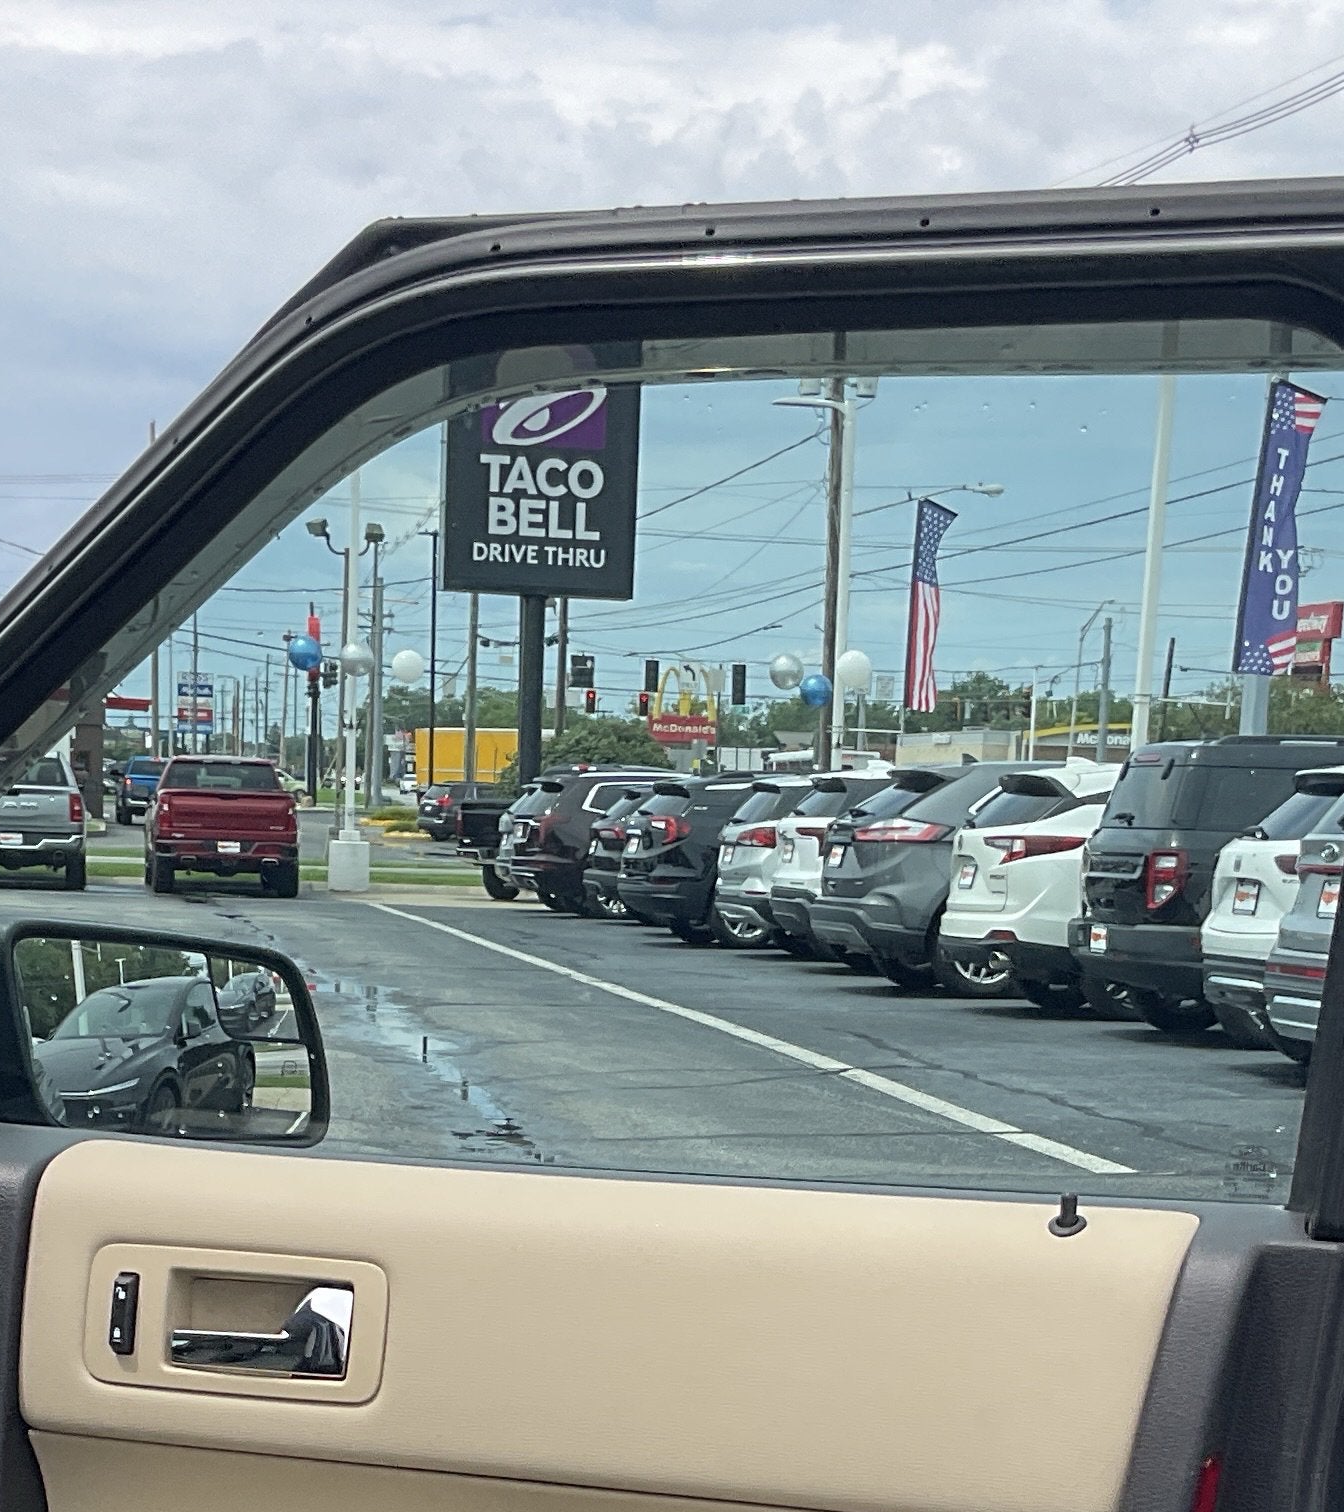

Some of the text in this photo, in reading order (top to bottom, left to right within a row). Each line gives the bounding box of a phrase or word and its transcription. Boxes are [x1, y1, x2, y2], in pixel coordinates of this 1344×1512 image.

[479, 453, 605, 499] TACO
[487, 497, 601, 541] BELL
[1258, 447, 1295, 621] THANK YOU
[472, 541, 606, 569] DRIVE THRU
[652, 722, 717, 735] McDonald's
